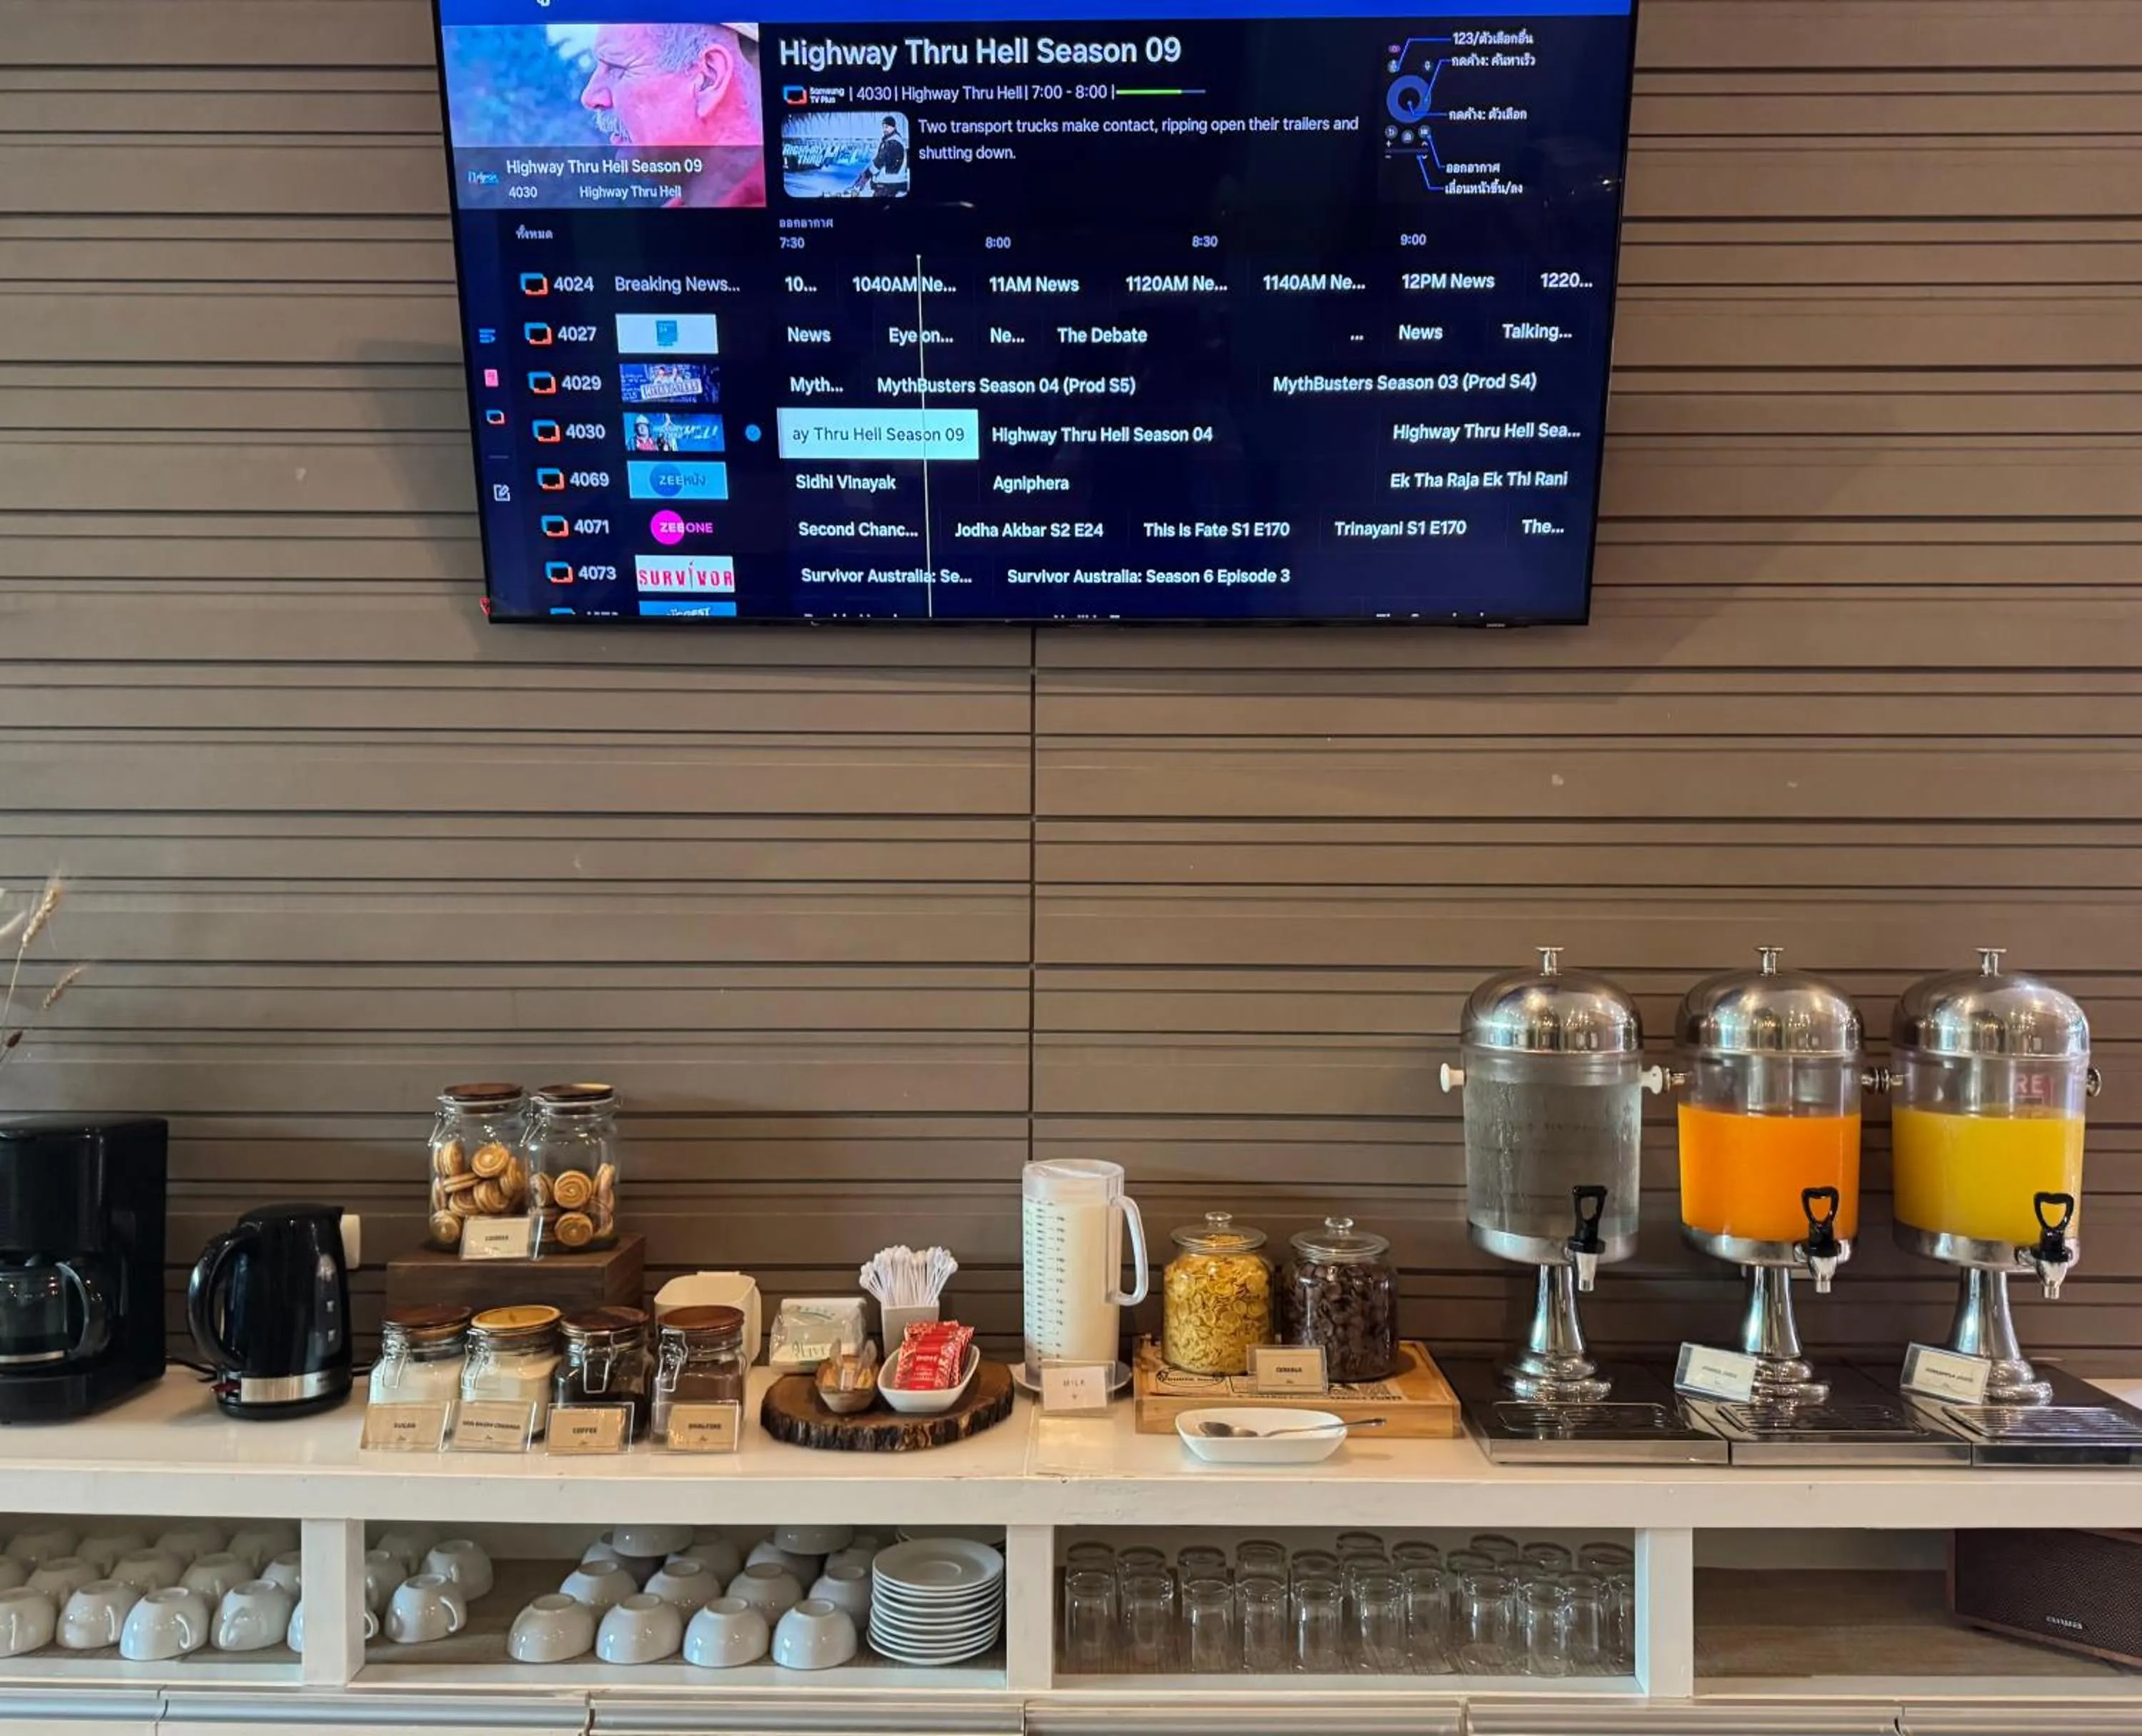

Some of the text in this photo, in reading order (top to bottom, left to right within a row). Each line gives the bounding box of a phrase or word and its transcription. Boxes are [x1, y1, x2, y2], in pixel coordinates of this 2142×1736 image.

[780, 36, 1181, 72] Highway Thru Hell Season 09
[901, 86, 960, 104] Highway
[962, 85, 994, 100] Thru
[997, 85, 1023, 99] Hell
[1032, 85, 1063, 99] 7:00
[1075, 84, 1108, 99] 8:00
[917, 116, 1359, 136] Two transport trucks make contact, ripping open their trailers and
[918, 145, 1016, 163] shutting down.
[506, 159, 565, 178] Highway
[566, 158, 599, 173] Thru
[602, 158, 629, 173] Hell
[630, 158, 681, 173] Season
[683, 158, 703, 173] 09
[508, 185, 538, 198] 4030
[578, 184, 682, 201] Highway Thru Hell
[779, 236, 805, 248] 7:30
[985, 236, 1012, 248] 8:00
[1192, 235, 1218, 248] 8:30
[1400, 233, 1427, 246] 9:00
[553, 276, 594, 291] 4024
[615, 275, 740, 296] Breaking News...
[785, 276, 817, 293] 10...
[852, 276, 957, 293] 1040AM Ne...
[989, 276, 1080, 293] 11AM News
[1125, 275, 1227, 292] 1120AM Ne...
[1262, 273, 1366, 291] 1140AM Ne...
[1402, 273, 1495, 289] 12PM News
[1540, 272, 1593, 288] 1220...
[558, 326, 597, 341] 4027
[787, 326, 831, 343] News
[888, 327, 954, 346] Eye on...
[990, 327, 1025, 343] Ne...
[1057, 326, 1148, 343] The Debate
[1399, 324, 1443, 340] News
[1502, 323, 1573, 343] Talking...
[561, 375, 602, 390] 4029
[790, 376, 843, 396] Myth...
[878, 375, 1136, 397] MythBusters Season 04 (Prod S5)
[1273, 371, 1537, 395] MythBusters Season 03 (Prod S4)
[565, 423, 606, 439] 4030
[793, 427, 965, 445] ay Thru Hell Season 09
[992, 426, 1213, 446] Highway Thru Hell Season 04
[1392, 422, 1581, 444] Highway Thru Hell Sea...
[570, 472, 610, 488] 4069
[659, 475, 683, 485] ZEE
[795, 474, 896, 493] Sidhi Vinayak
[992, 475, 1070, 494] Agniphera
[1390, 470, 1568, 491] Ek Tha Raja Ek Thi Rani
[574, 519, 609, 534] 4071
[659, 522, 713, 534] ZEE ONE
[798, 521, 918, 537] Second Chanc...
[955, 522, 1104, 538] Jodha Akbar S2 E24
[1143, 522, 1176, 538] This
[1195, 522, 1229, 538] Fate
[1232, 522, 1250, 537] S1
[1254, 521, 1290, 537] E170
[1334, 520, 1467, 540] Trinayani S1 E170
[1522, 518, 1564, 534] The...
[578, 565, 617, 580] 4073
[638, 561, 734, 589] SURVIVOR
[800, 567, 972, 584] Survivor Australia: Se...
[1007, 567, 1290, 586] Survivor Australia: Season 6 Episode 3
